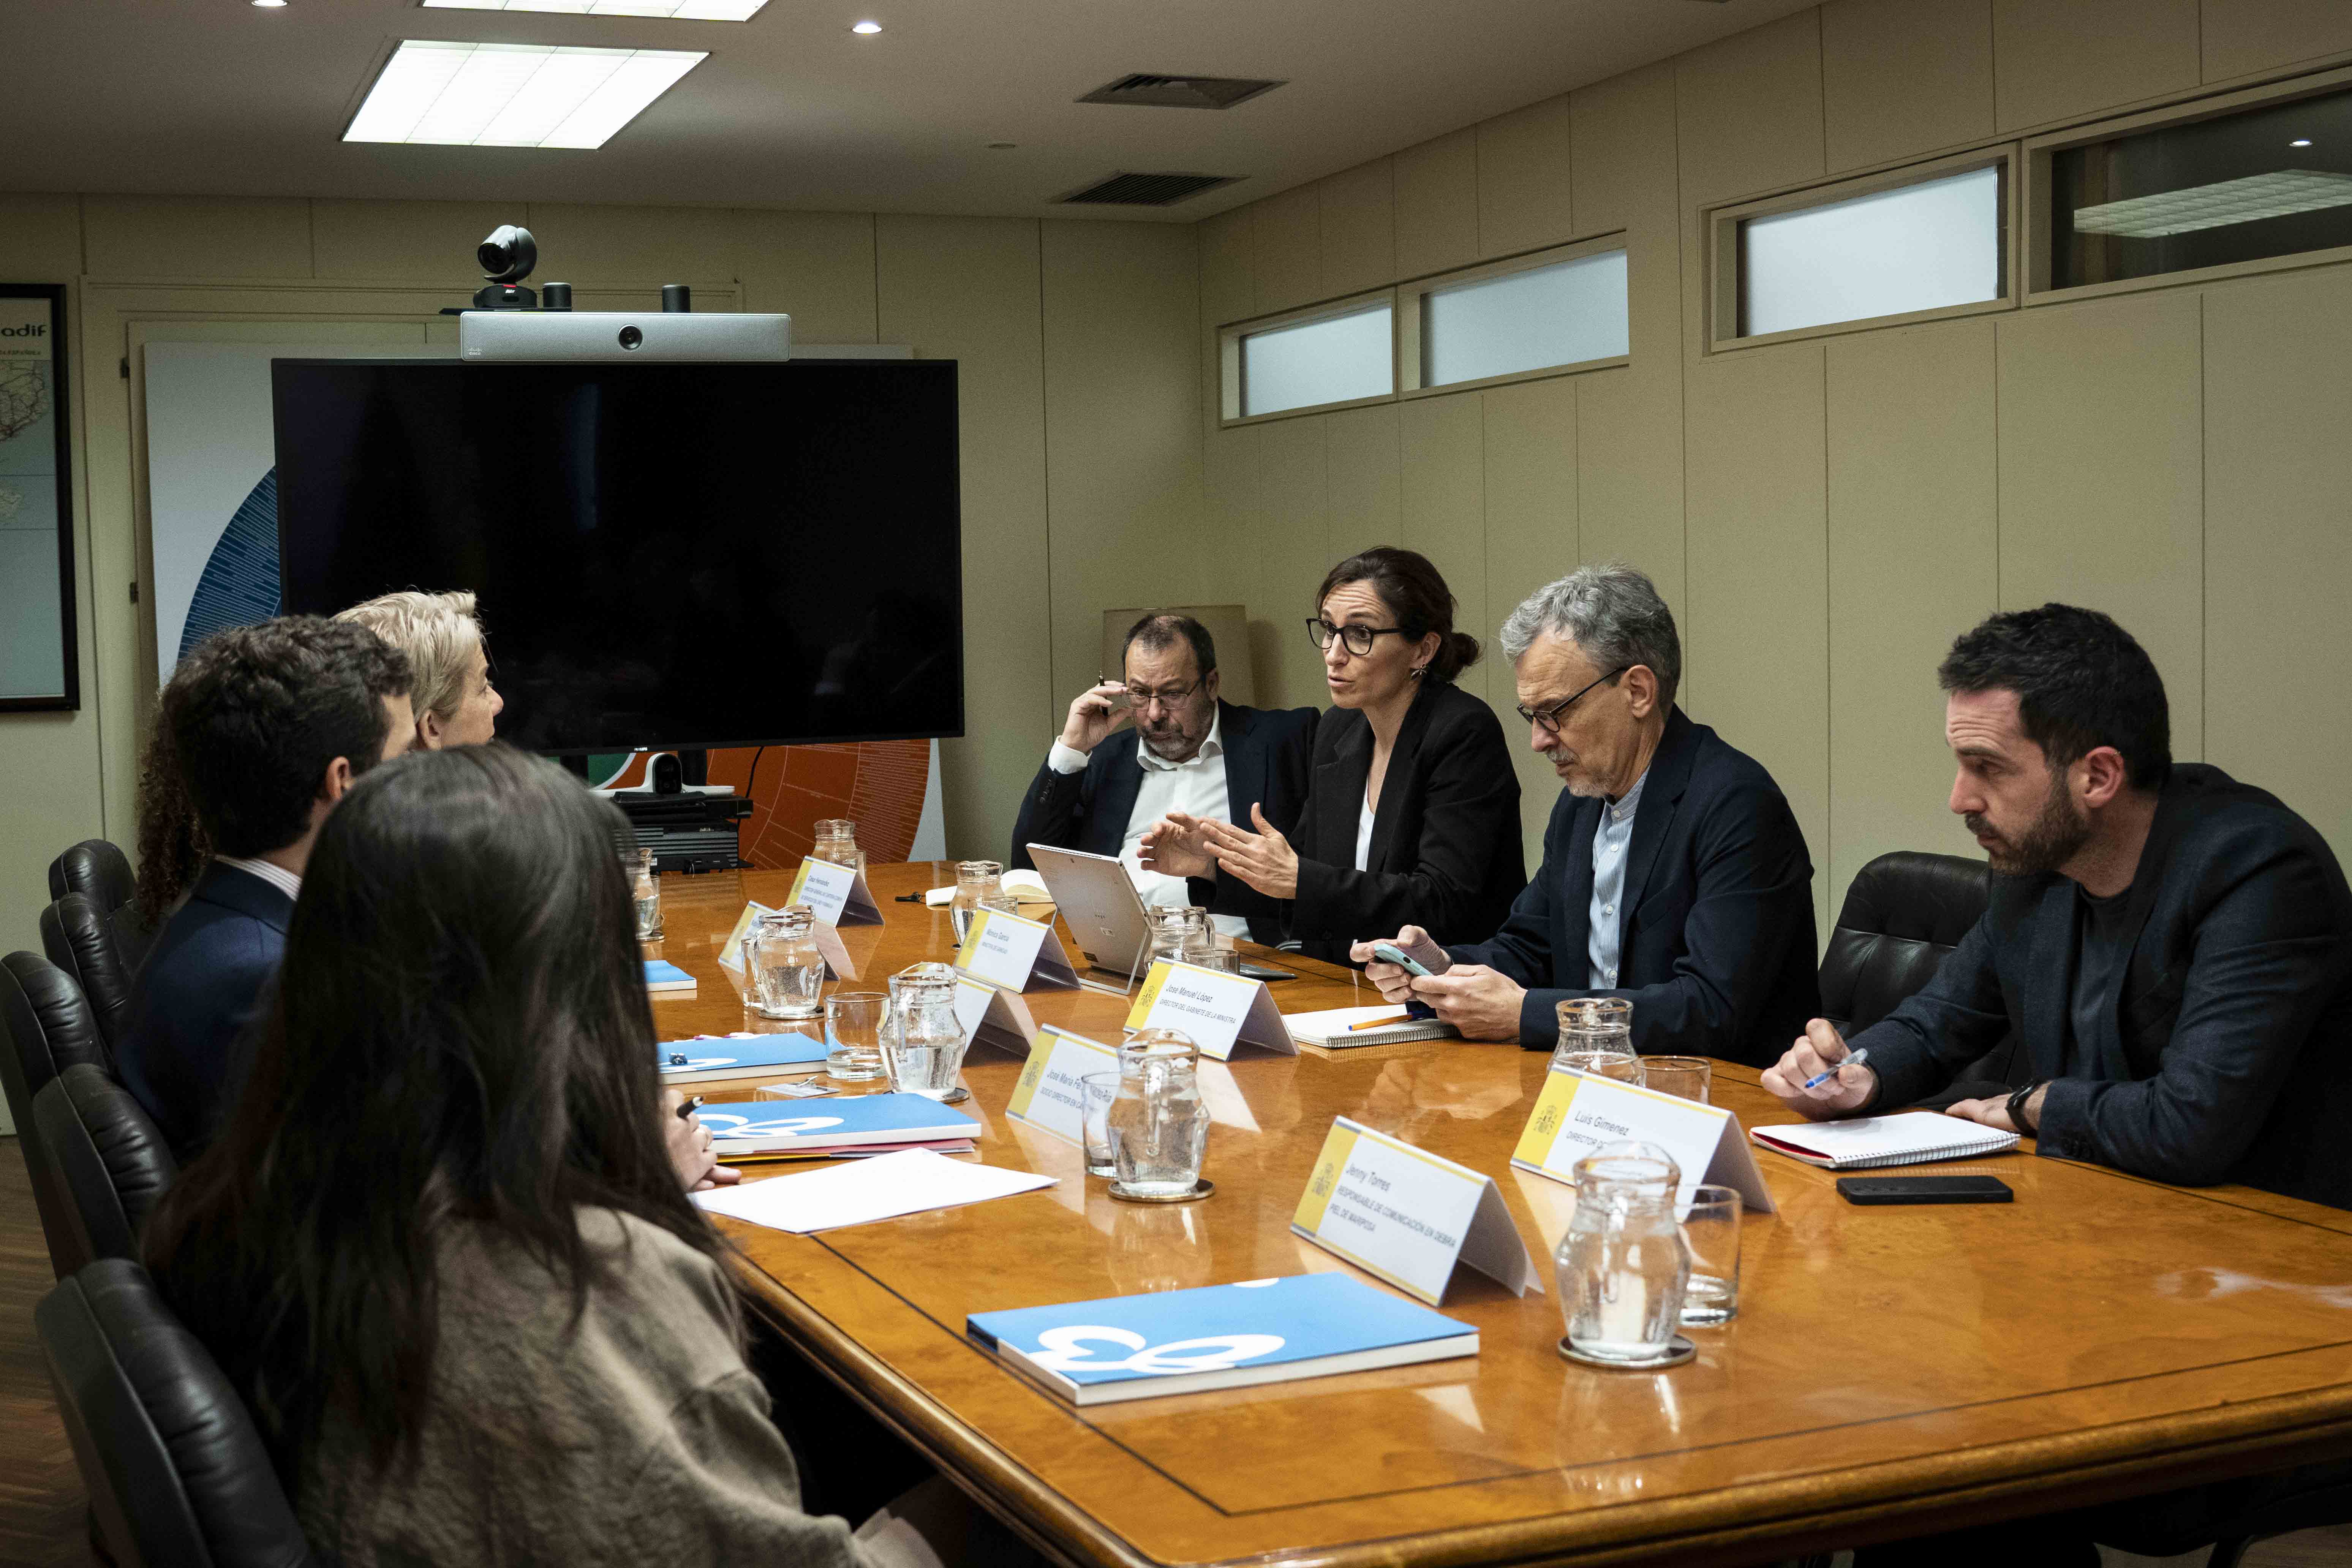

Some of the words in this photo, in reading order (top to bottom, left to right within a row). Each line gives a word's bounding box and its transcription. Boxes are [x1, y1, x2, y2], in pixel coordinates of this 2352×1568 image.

[1, 324, 47, 337] adif
[1179, 986, 1199, 998] Manuel
[1197, 991, 1213, 1003] López
[1159, 998, 1179, 1009] DIRECTOR
[1186, 1005, 1206, 1016] GABINETE
[1217, 1013, 1236, 1024] MINISTRA
[1575, 1110, 1592, 1124] Luis
[1566, 1131, 1598, 1146] DIRECTOR
[1346, 1162, 1367, 1183] Jenny
[1368, 1171, 1391, 1192] Torres
[1337, 1185, 1375, 1209] RESPONSABLE
[1373, 1202, 1384, 1213] DE
[1424, 1226, 1435, 1237] EN
[1434, 1231, 1457, 1248] DEBRA
